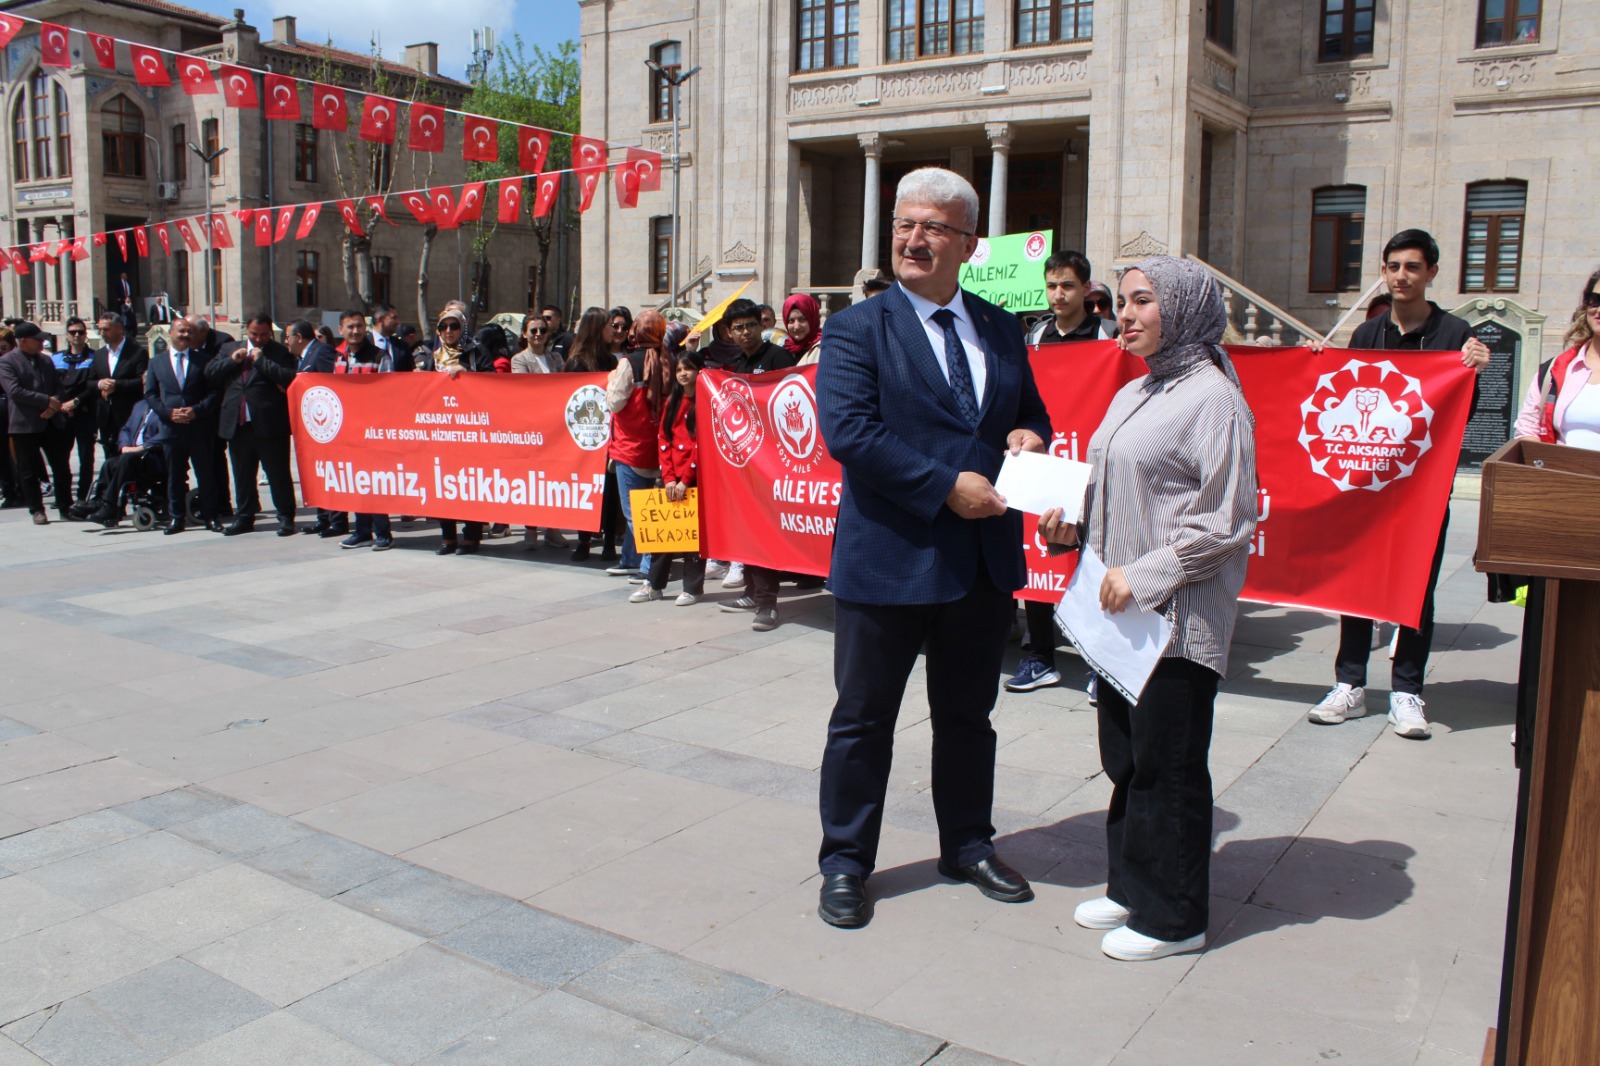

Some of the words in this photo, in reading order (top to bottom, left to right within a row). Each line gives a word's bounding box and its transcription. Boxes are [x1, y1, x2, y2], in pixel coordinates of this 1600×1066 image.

[442, 396, 459, 408] T.C.
[415, 413, 453, 425] AKSARAY
[454, 411, 490, 426] VALİLİĞİ
[364, 426, 384, 440] AİLE
[386, 429, 397, 440] VE
[398, 429, 430, 441] SOSYAL
[431, 428, 478, 443] HİZMETLER
[480, 429, 489, 443] İL
[490, 430, 544, 446] MÜDÜRLÜĞÜ
[776, 441, 791, 467] 2025
[1325, 442, 1346, 455] T.C.
[1347, 444, 1407, 458] AKSARAY
[1338, 457, 1390, 472] VALİLİĞİ
[773, 474, 807, 504] AİLE
[808, 480, 829, 505] VE
